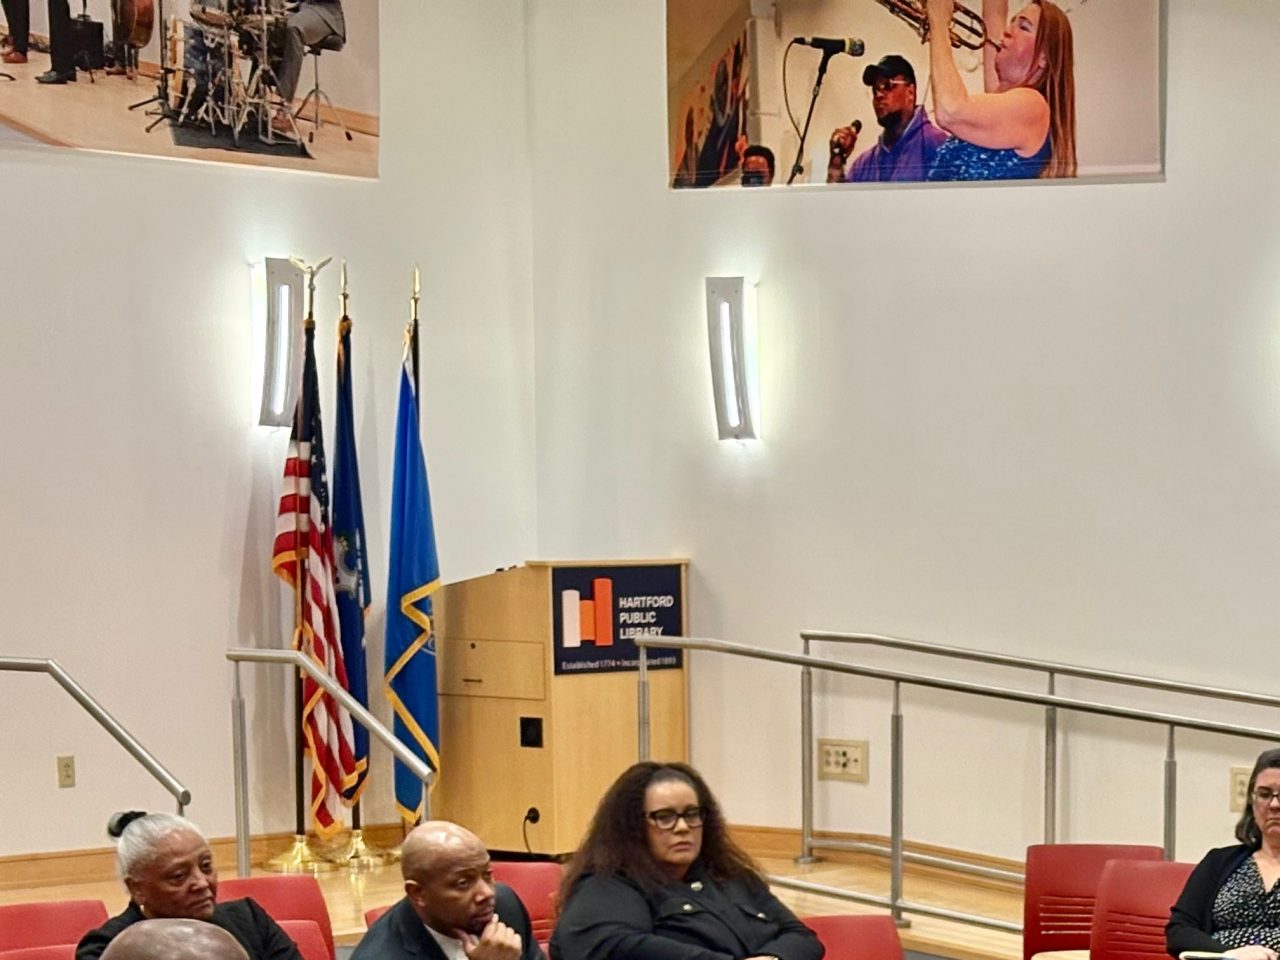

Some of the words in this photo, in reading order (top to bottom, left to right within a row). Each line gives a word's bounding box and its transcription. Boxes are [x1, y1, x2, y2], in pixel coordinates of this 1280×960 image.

[619, 596, 674, 608] HARTFORD
[619, 611, 657, 624] PUBLIC
[619, 626, 663, 639] LIBRARY
